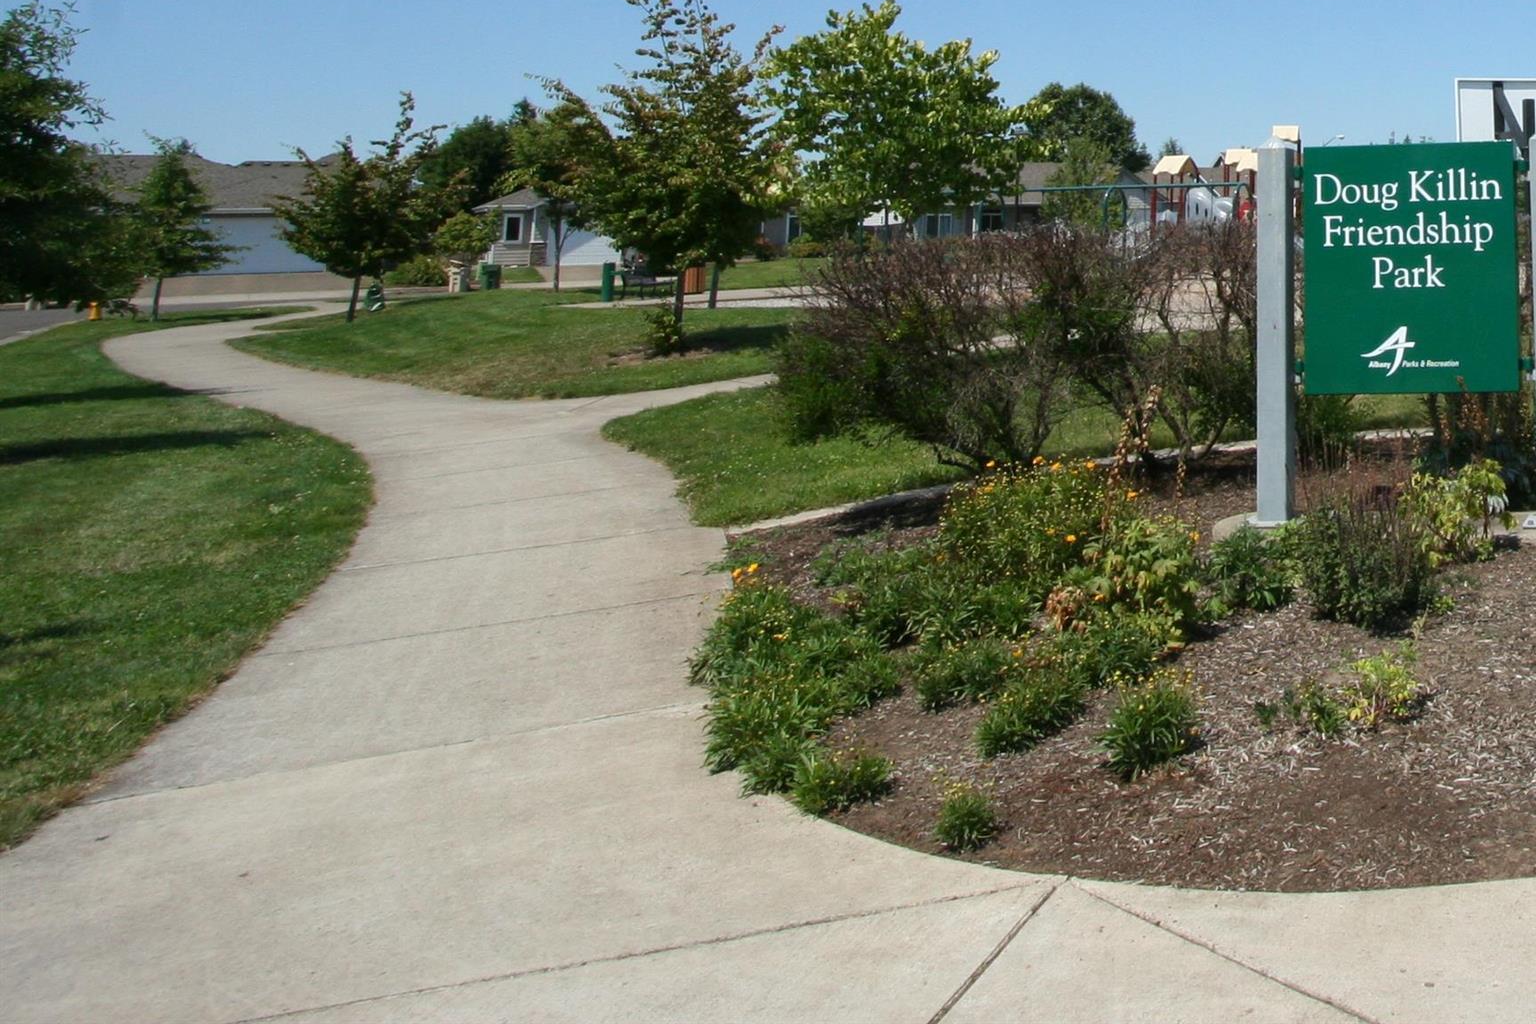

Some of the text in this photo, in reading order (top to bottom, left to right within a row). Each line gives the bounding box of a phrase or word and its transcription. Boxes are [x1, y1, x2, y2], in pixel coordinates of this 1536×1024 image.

[1313, 167, 1503, 211] Doug Killin
[1322, 211, 1494, 252] Friendship
[1371, 254, 1446, 289] Park
[1401, 360, 1419, 368] Parks
[1426, 359, 1460, 368] Recreation
